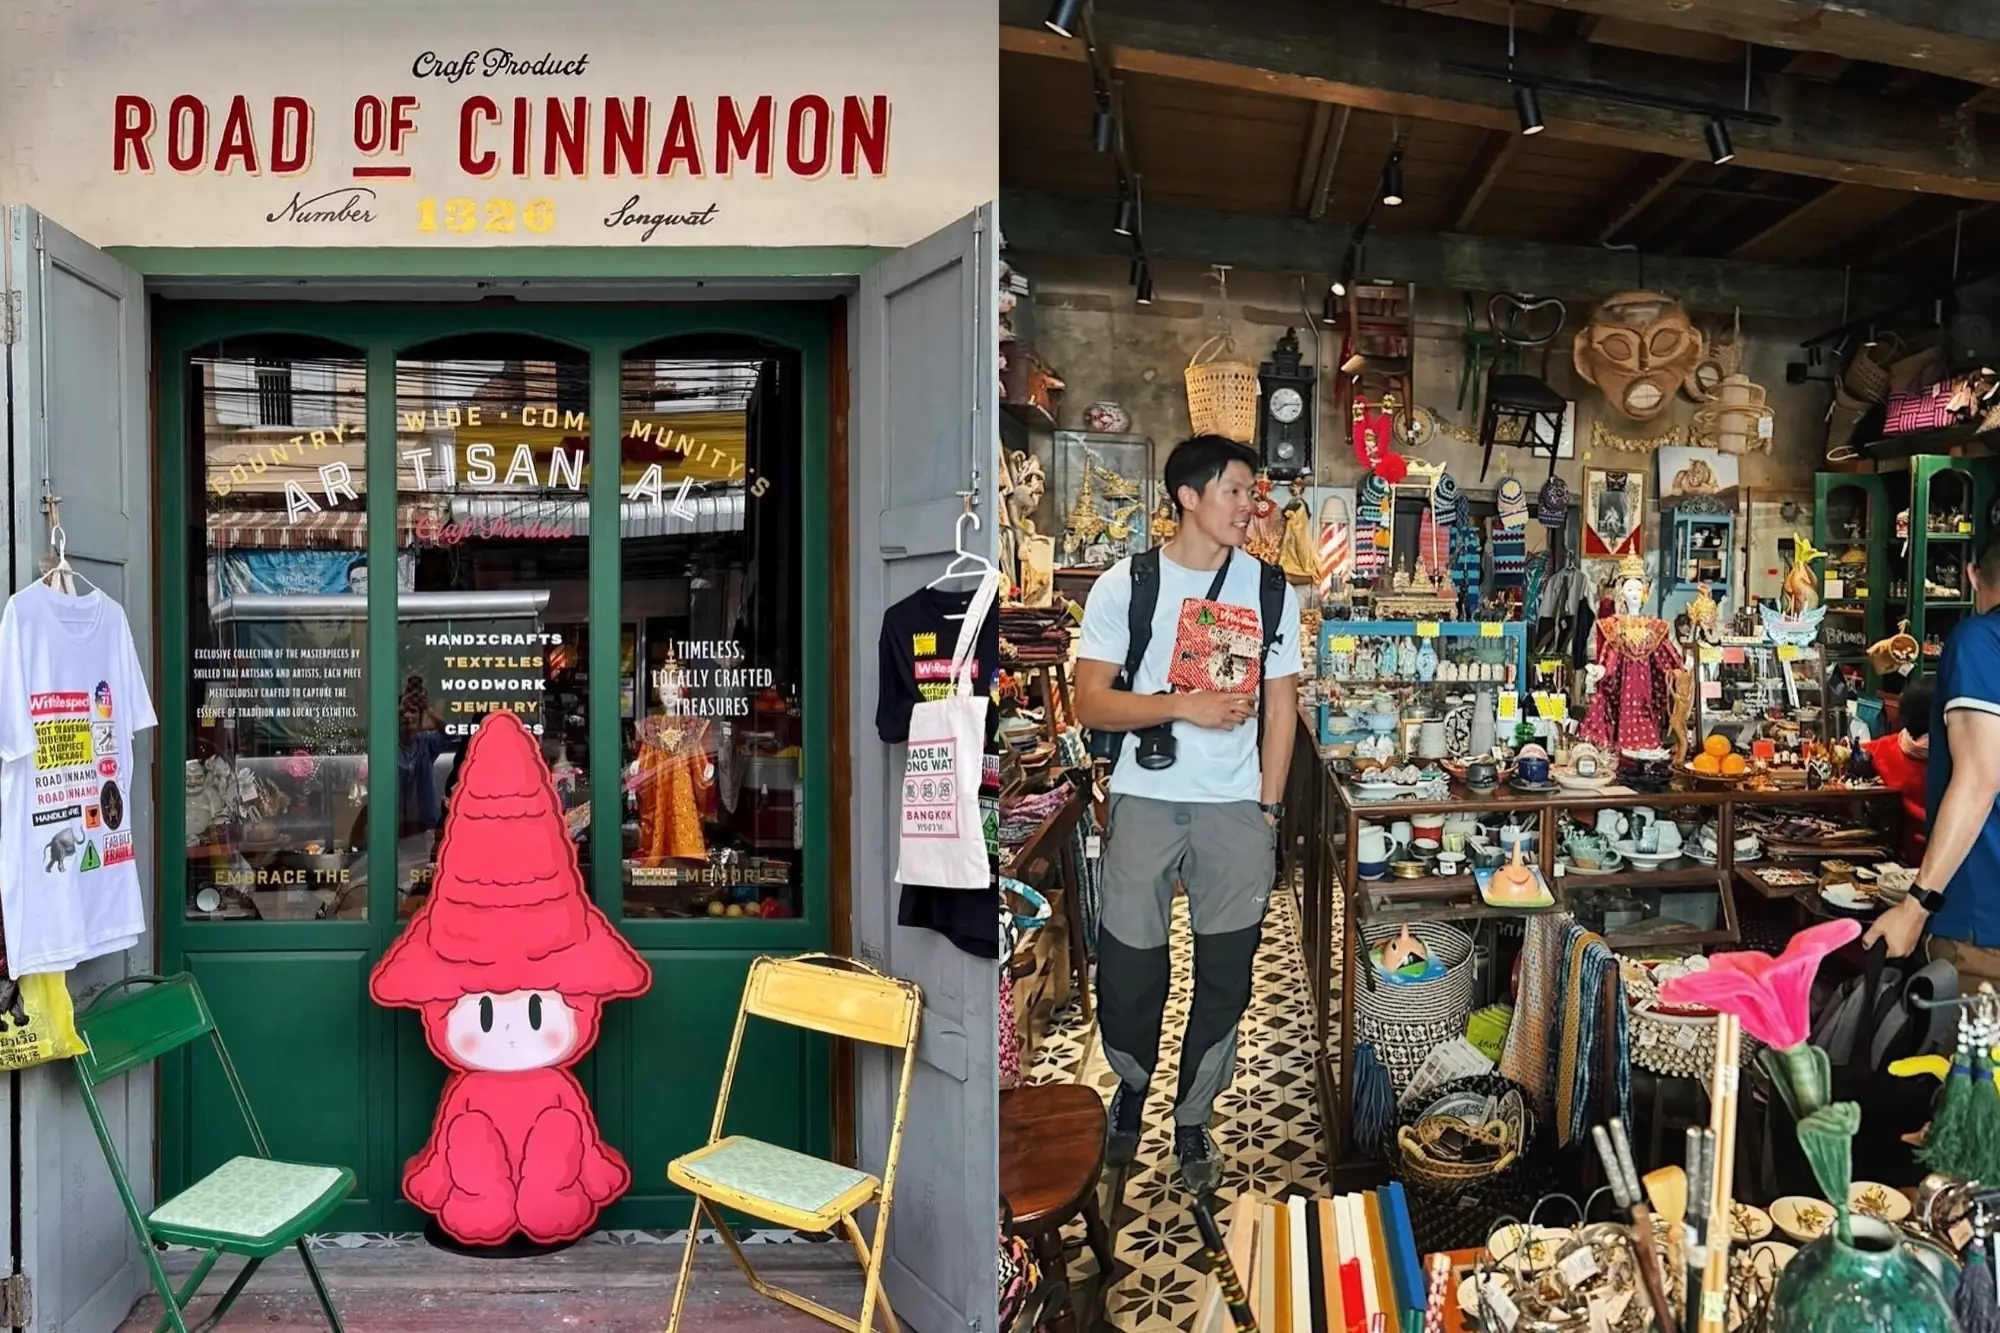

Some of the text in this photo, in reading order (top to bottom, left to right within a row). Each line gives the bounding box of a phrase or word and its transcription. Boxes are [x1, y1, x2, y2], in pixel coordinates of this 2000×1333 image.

[412, 48, 590, 83] Craft Product
[113, 94, 889, 177] ROAD OF CINNAMON
[266, 187, 719, 242] Number 1326 Songwat
[404, 406, 481, 432] WIDE
[522, 406, 585, 431] COM
[284, 443, 695, 524] AR TISAN AL
[425, 634, 563, 645] HANDICRAFTS
[194, 648, 360, 660] EXCLUSIVE COLLECTION OF THE MASTERPIECES BY
[677, 640, 745, 660] TIMELESS,
[444, 656, 544, 668] TEXTILES
[194, 668, 221, 679] SKILLED
[222, 668, 238, 679] THAI
[240, 668, 274, 679] ARTISANS
[275, 668, 290, 679] AND
[324, 668, 341, 679] EACH
[343, 668, 361, 679] PIECE
[652, 668, 773, 687] LOCALLY CRAFTED
[441, 679, 547, 690] WOODWORK
[209, 687, 346, 698] METICULOUSLY CRAFTED TO CAPTURE THE
[197, 707, 225, 718] ESSENCE
[227, 707, 236, 718] OF
[238, 707, 274, 718] TRADITION
[275, 707, 290, 718] AND
[292, 707, 320, 718] LOCAL'S
[451, 701, 538, 713] JEWELRY
[676, 697, 749, 716] TREASURES
[938, 747, 948, 757] IN
[932, 758, 953, 771] WAT
[35, 774, 62, 788] ROAD
[38, 791, 65, 805] ROAD
[35, 810, 68, 824] HANDLE
[906, 810, 952, 821] BANGKOK
[215, 869, 307, 884] EMBRACE
[313, 869, 350, 883] THE
